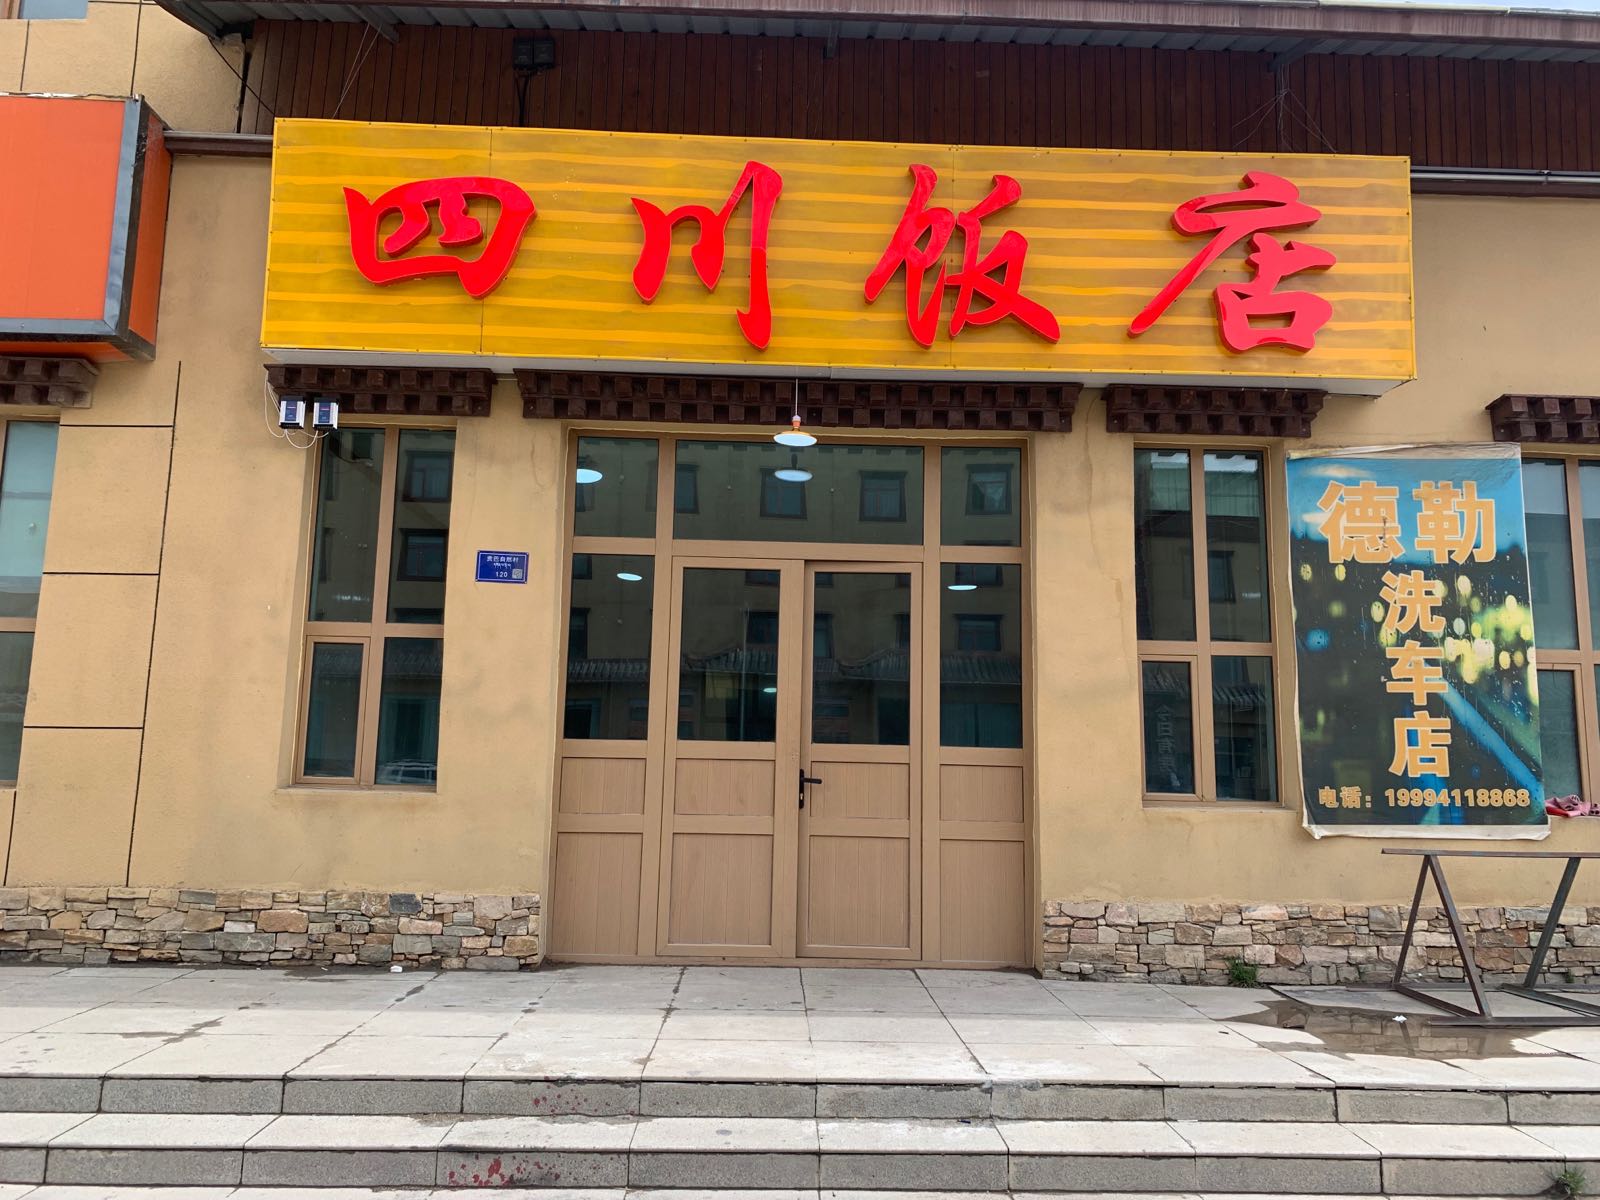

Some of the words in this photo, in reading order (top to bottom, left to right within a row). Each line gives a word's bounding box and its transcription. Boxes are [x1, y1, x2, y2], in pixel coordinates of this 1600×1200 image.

[344, 161, 1333, 354] 四川饭店
[1317, 480, 1497, 565] 德勒
[1378, 570, 1452, 778] 洗车店
[1384, 788, 1530, 807] 19994118868
